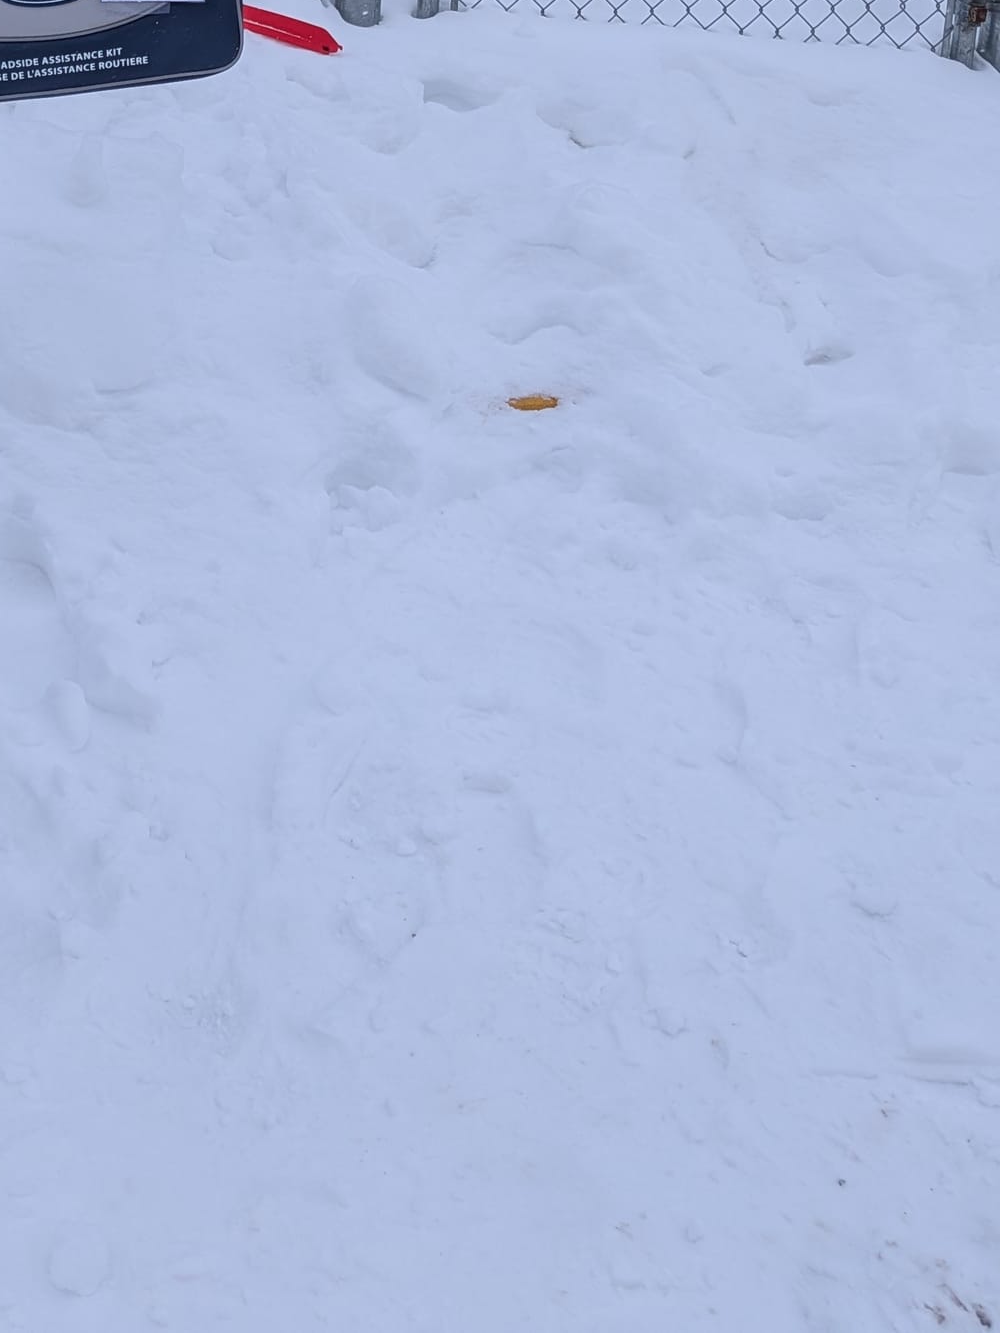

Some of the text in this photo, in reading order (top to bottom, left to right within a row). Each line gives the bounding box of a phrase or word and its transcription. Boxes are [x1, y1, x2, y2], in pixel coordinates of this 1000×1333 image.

[11, 71, 25, 80] DE
[27, 61, 96, 79] L'ASSISTANCE
[98, 55, 149, 70] ROUTIERE
[42, 50, 104, 66] ASSISTANCE
[106, 47, 123, 57] KIT
